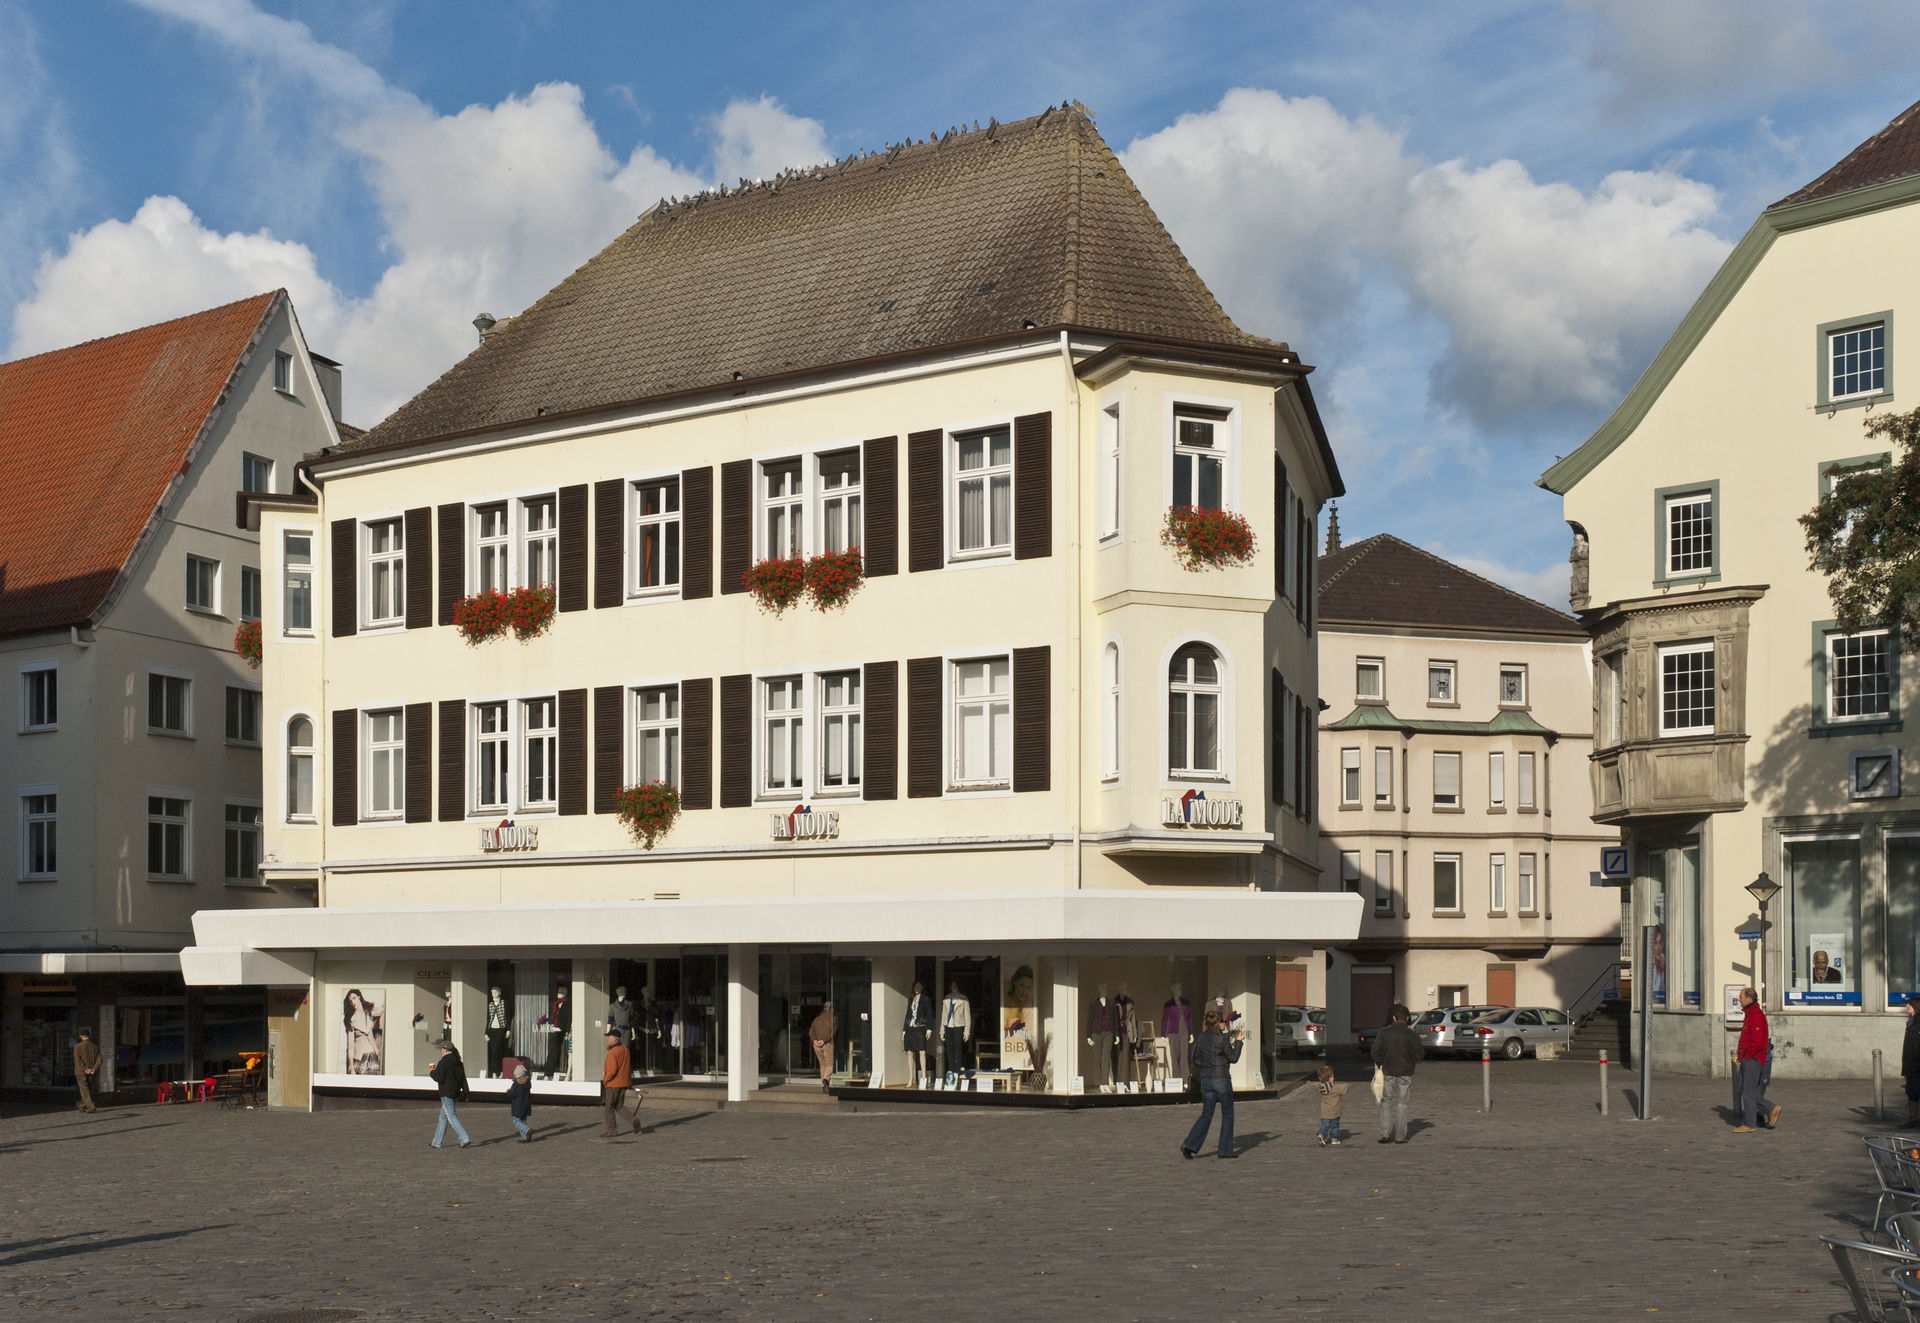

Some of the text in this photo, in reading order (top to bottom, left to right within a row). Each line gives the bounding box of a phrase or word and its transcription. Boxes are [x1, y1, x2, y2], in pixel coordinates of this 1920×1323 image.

[771, 811, 839, 838] LA MODE
[1161, 797, 1243, 826] LA MODE
[479, 826, 537, 849] LA MODE
